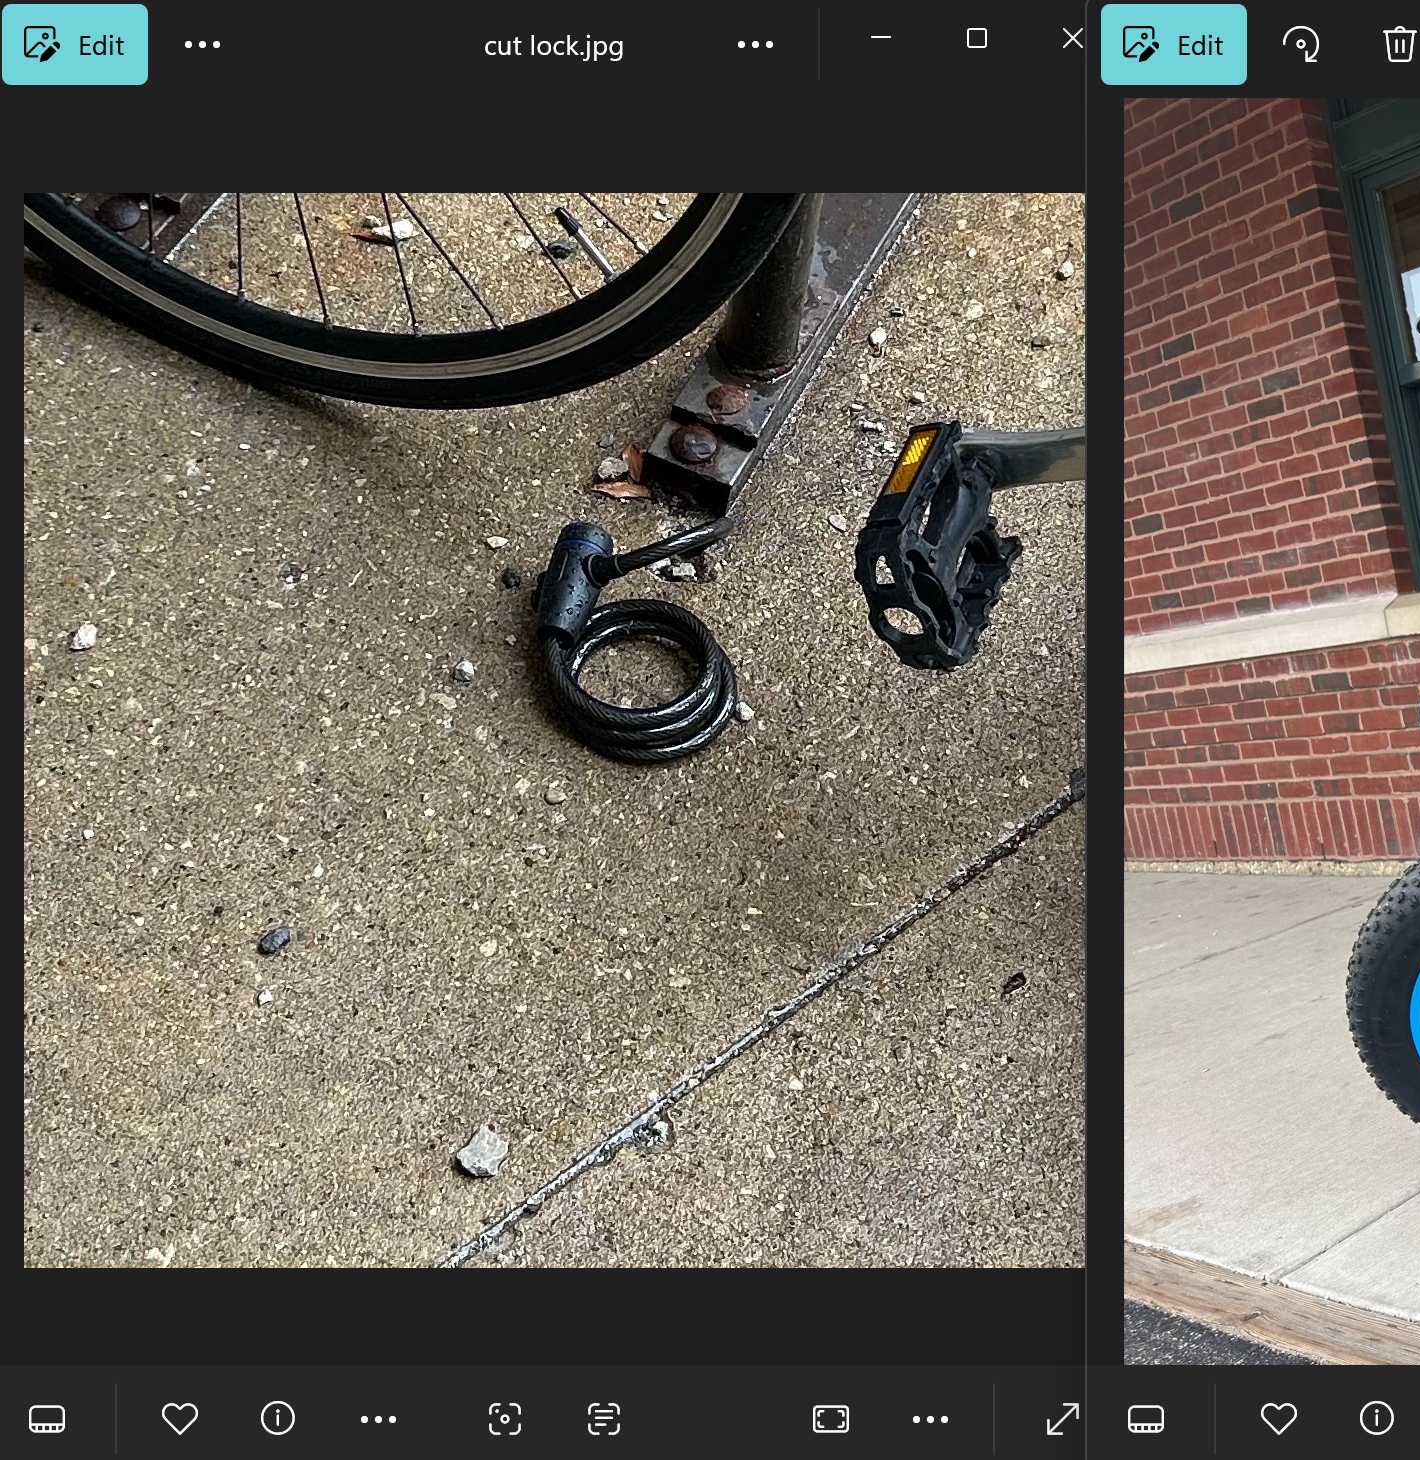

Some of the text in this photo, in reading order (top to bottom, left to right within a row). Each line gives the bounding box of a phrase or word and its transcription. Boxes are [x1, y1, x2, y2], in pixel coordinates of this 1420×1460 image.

[80, 34, 125, 56] Edit
[484, 33, 624, 62] cut lock.jpg
[1179, 34, 1224, 56] Edit
